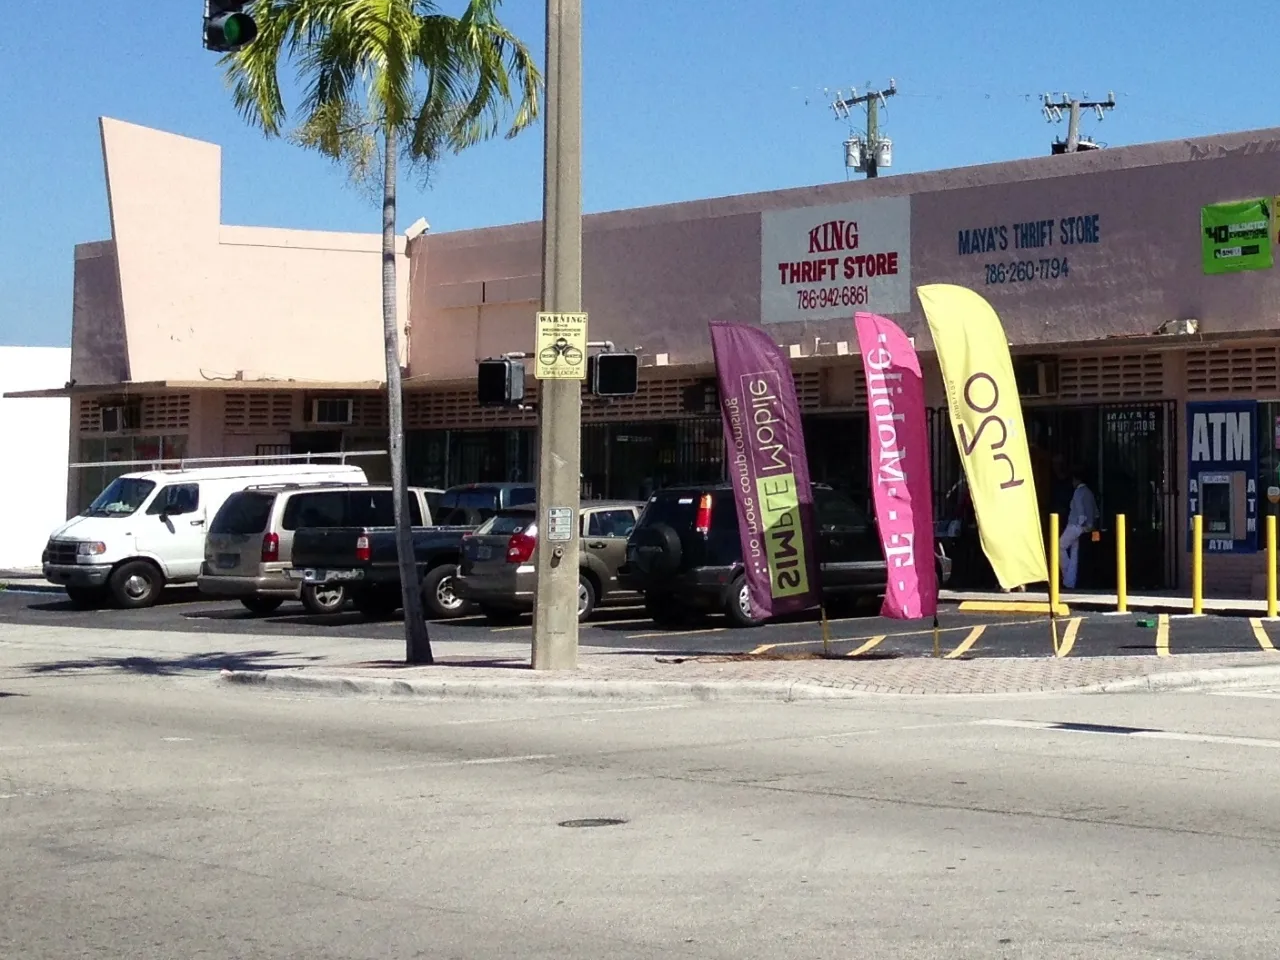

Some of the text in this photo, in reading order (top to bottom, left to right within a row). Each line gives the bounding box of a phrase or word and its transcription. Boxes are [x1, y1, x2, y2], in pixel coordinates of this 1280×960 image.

[808, 220, 859, 253] KING
[958, 214, 1100, 256] MAYA'S THRIFT STORE
[778, 252, 898, 285] THRIFT STORE
[1191, 412, 1251, 462] ATM
[1247, 479, 1256, 532] ATM
[1209, 539, 1234, 550] ATM
